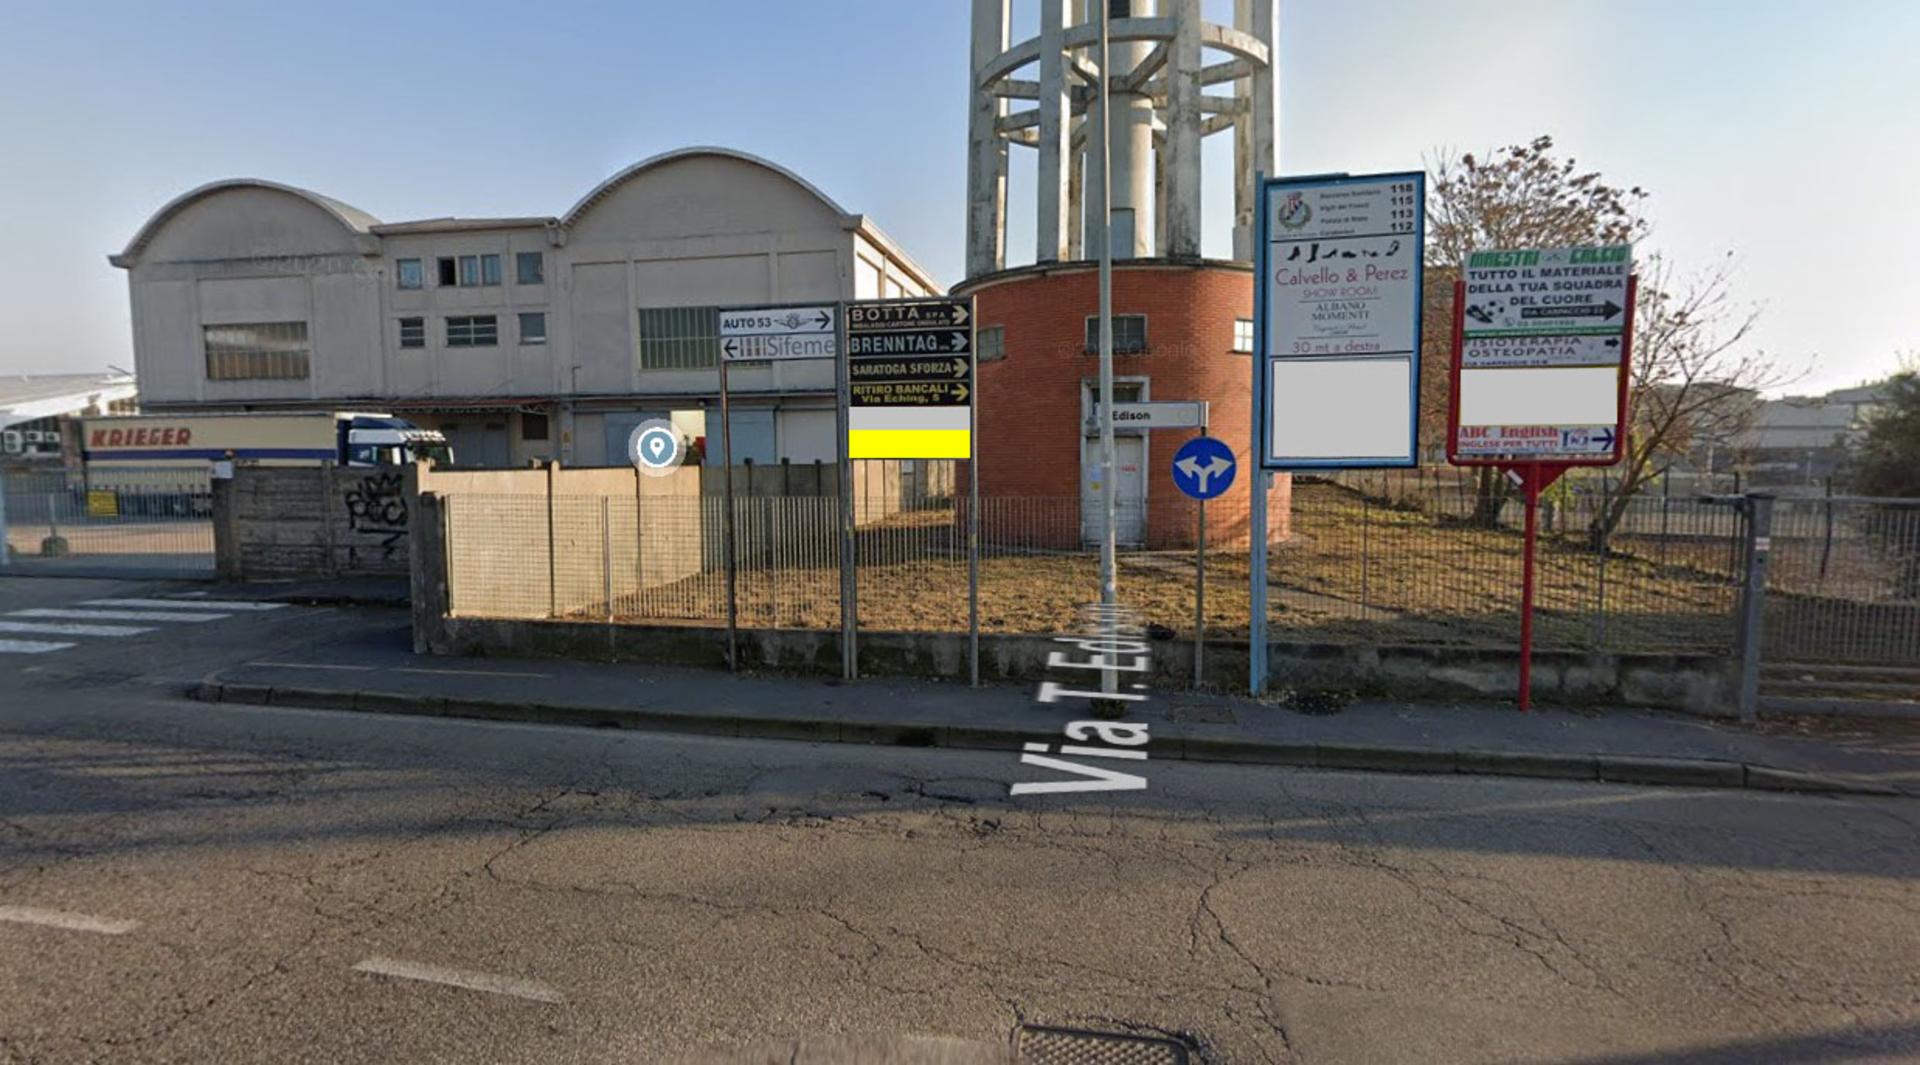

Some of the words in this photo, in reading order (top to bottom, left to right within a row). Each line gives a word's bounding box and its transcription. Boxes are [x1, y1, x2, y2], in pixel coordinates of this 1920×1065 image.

[1391, 184, 1413, 193] 118
[1391, 196, 1414, 205] 115
[1390, 210, 1413, 219] 113
[1391, 222, 1413, 231] 112
[1275, 266, 1340, 286] Calvello
[1346, 268, 1359, 283] &
[1365, 264, 1409, 282] Perez
[1469, 269, 1517, 281] TUTTO
[1522, 268, 1536, 279] IL
[1540, 265, 1624, 278] MATERIALE
[1468, 283, 1514, 294] DELLA
[1518, 281, 1548, 292] TUA
[1553, 279, 1623, 291] SQUADRA
[1510, 294, 1539, 306] DEL
[1542, 294, 1593, 305] CUORE
[1316, 302, 1366, 311] ALBANO
[852, 307, 919, 321] BOTTA
[1312, 311, 1370, 320] MOMENTI
[723, 317, 756, 329] AUTO
[758, 317, 772, 328] 53
[767, 336, 834, 357] Sifeme
[851, 335, 938, 353] BRENNTAG
[1292, 341, 1311, 353] 30
[1315, 342, 1329, 353] mt
[1345, 340, 1381, 352] destra
[1469, 347, 1576, 358] OSTEOPATIA
[853, 364, 907, 376] SARATOGA
[910, 362, 952, 374] SFORZA
[853, 385, 892, 395] RITIRO
[896, 384, 948, 394] BANCALI
[861, 395, 881, 403] Via
[1113, 410, 1151, 421] Edison
[90, 428, 192, 448] KRIEGER
